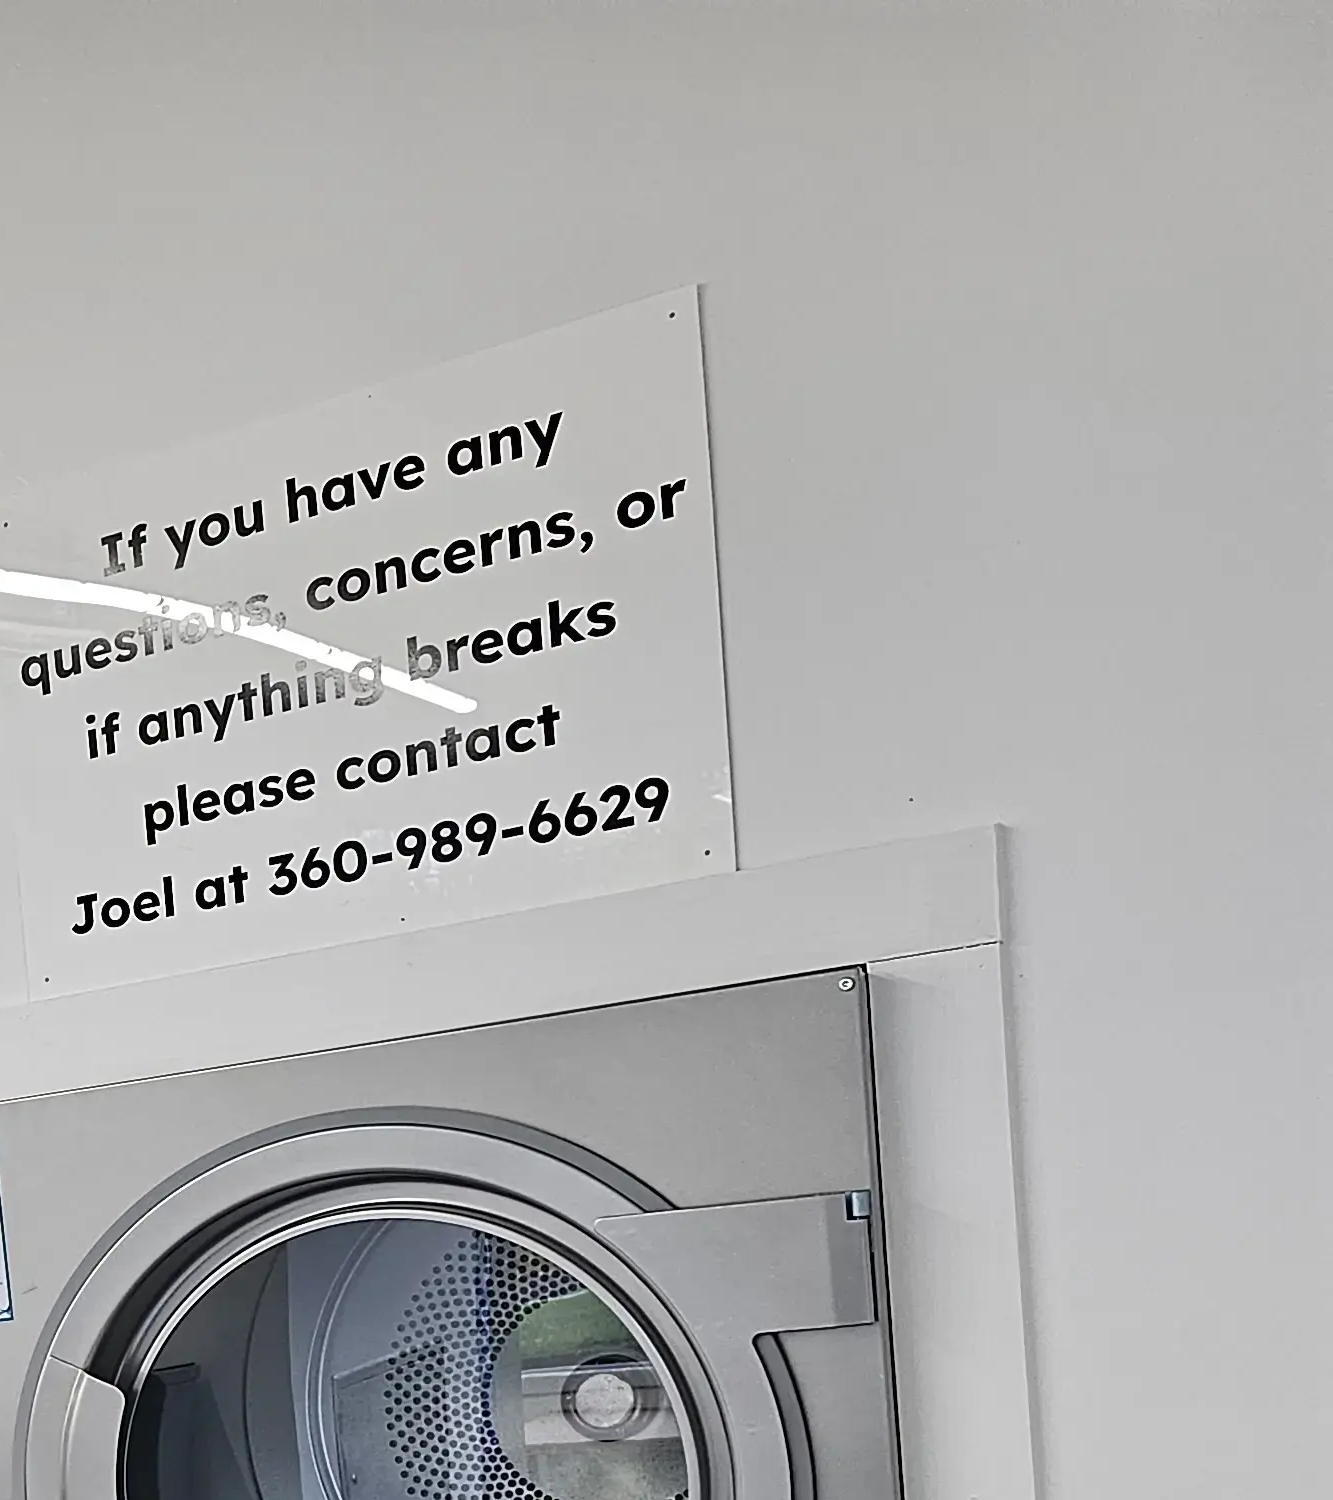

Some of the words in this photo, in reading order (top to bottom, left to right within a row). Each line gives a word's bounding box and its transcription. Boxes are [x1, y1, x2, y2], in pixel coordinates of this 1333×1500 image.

[101, 524, 147, 577] If
[164, 500, 264, 570] you
[286, 456, 425, 523] have
[448, 412, 563, 475] any
[21, 594, 286, 695] questions,
[307, 512, 593, 610] concerns,
[617, 479, 686, 528] or
[86, 712, 120, 759] if
[139, 660, 381, 745] anything
[407, 600, 616, 681] breaks
[144, 769, 315, 845] please
[337, 705, 560, 789] contact
[72, 876, 174, 934] Joel
[196, 866, 248, 909] at
[269, 778, 669, 895] 360-989-6629
